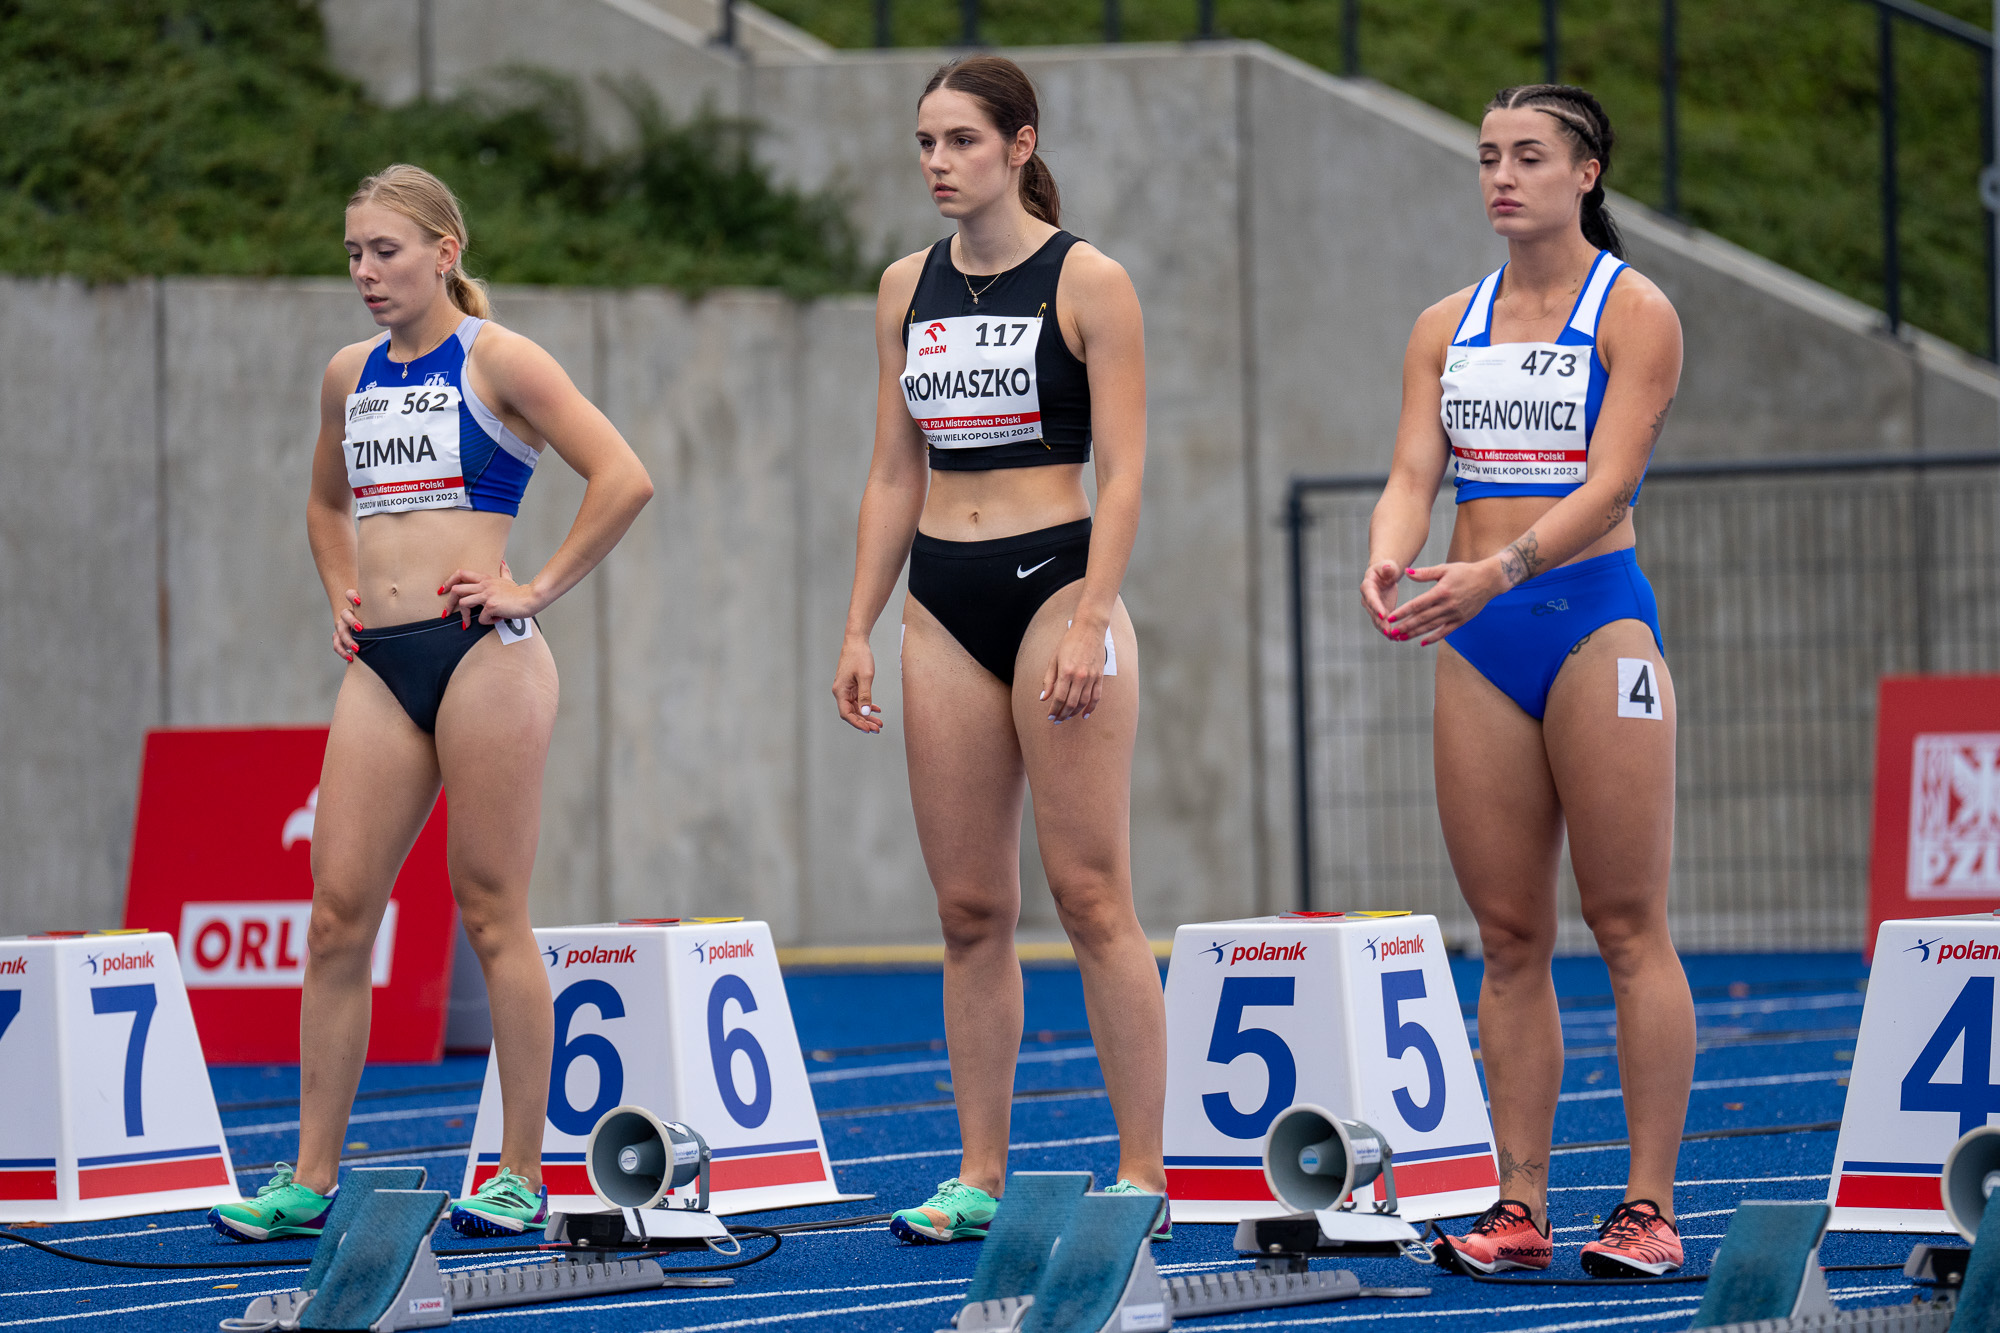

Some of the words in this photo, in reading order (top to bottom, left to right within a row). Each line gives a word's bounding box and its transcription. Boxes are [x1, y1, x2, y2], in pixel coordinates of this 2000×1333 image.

[975, 323, 1028, 347] 117
[919, 345, 947, 356] ORLEN
[1521, 350, 1577, 377] 473
[904, 367, 1031, 401] ROMASZKO
[401, 392, 448, 415] 562
[1446, 400, 1577, 431] STEFANOWICZ
[943, 431, 1010, 441] WIELKOPOLSKI
[1011, 426, 1035, 437] 2023
[946, 418, 993, 428] Mistrzostwa
[995, 415, 1021, 425] Polski
[352, 434, 437, 470] ZIMNA
[1485, 451, 1536, 461] Mistrzostwa
[1538, 452, 1566, 461] Polski
[1482, 466, 1551, 475] WIELKOPOLSKI
[1554, 467, 1578, 476] 2023
[377, 482, 419, 494] Mistrzostwa
[420, 480, 445, 490] Polski
[377, 495, 434, 508] WIELKOPOLSKI
[436, 492, 458, 502] 2023
[1629, 665, 1655, 714] 4
[193, 918, 298, 972] ORL
[1937, 939, 2000, 965] polan
[90, 983, 157, 1138] 7
[546, 978, 626, 1136] 6
[706, 973, 772, 1130] 6
[1201, 976, 1297, 1140] 5
[1380, 969, 1446, 1133] 5
[1900, 976, 2000, 1138] 4
